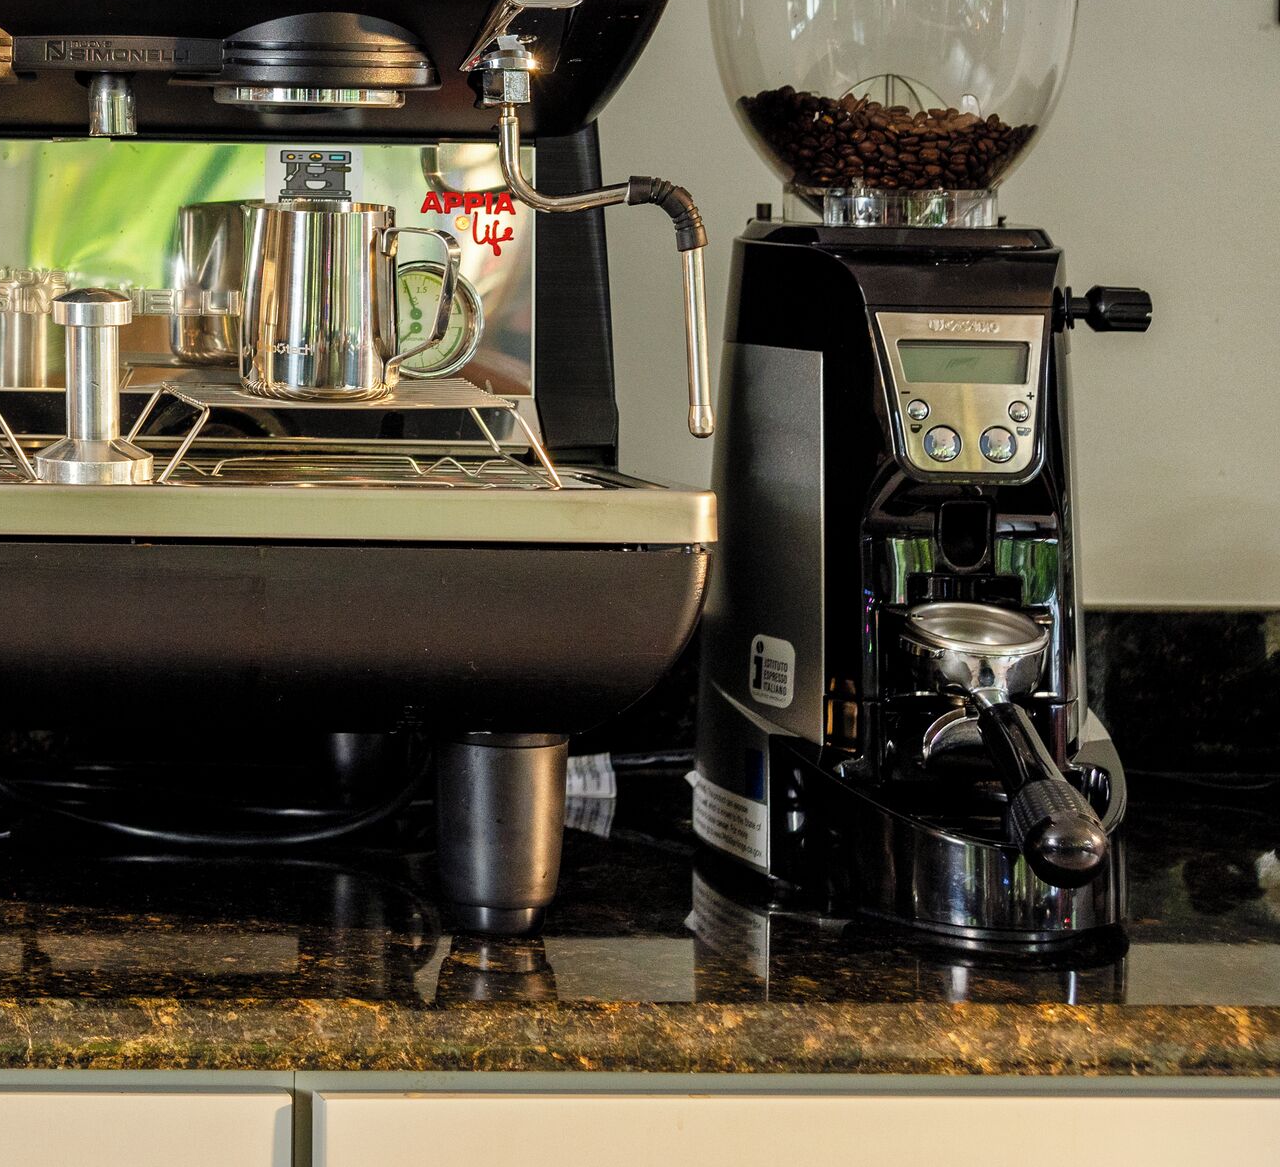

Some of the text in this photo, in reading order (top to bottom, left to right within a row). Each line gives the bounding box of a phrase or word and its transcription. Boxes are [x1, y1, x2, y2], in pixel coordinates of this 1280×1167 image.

[69, 48, 189, 63] SIMONELLI
[420, 191, 517, 215] APPIA
[473, 211, 515, 257] life
